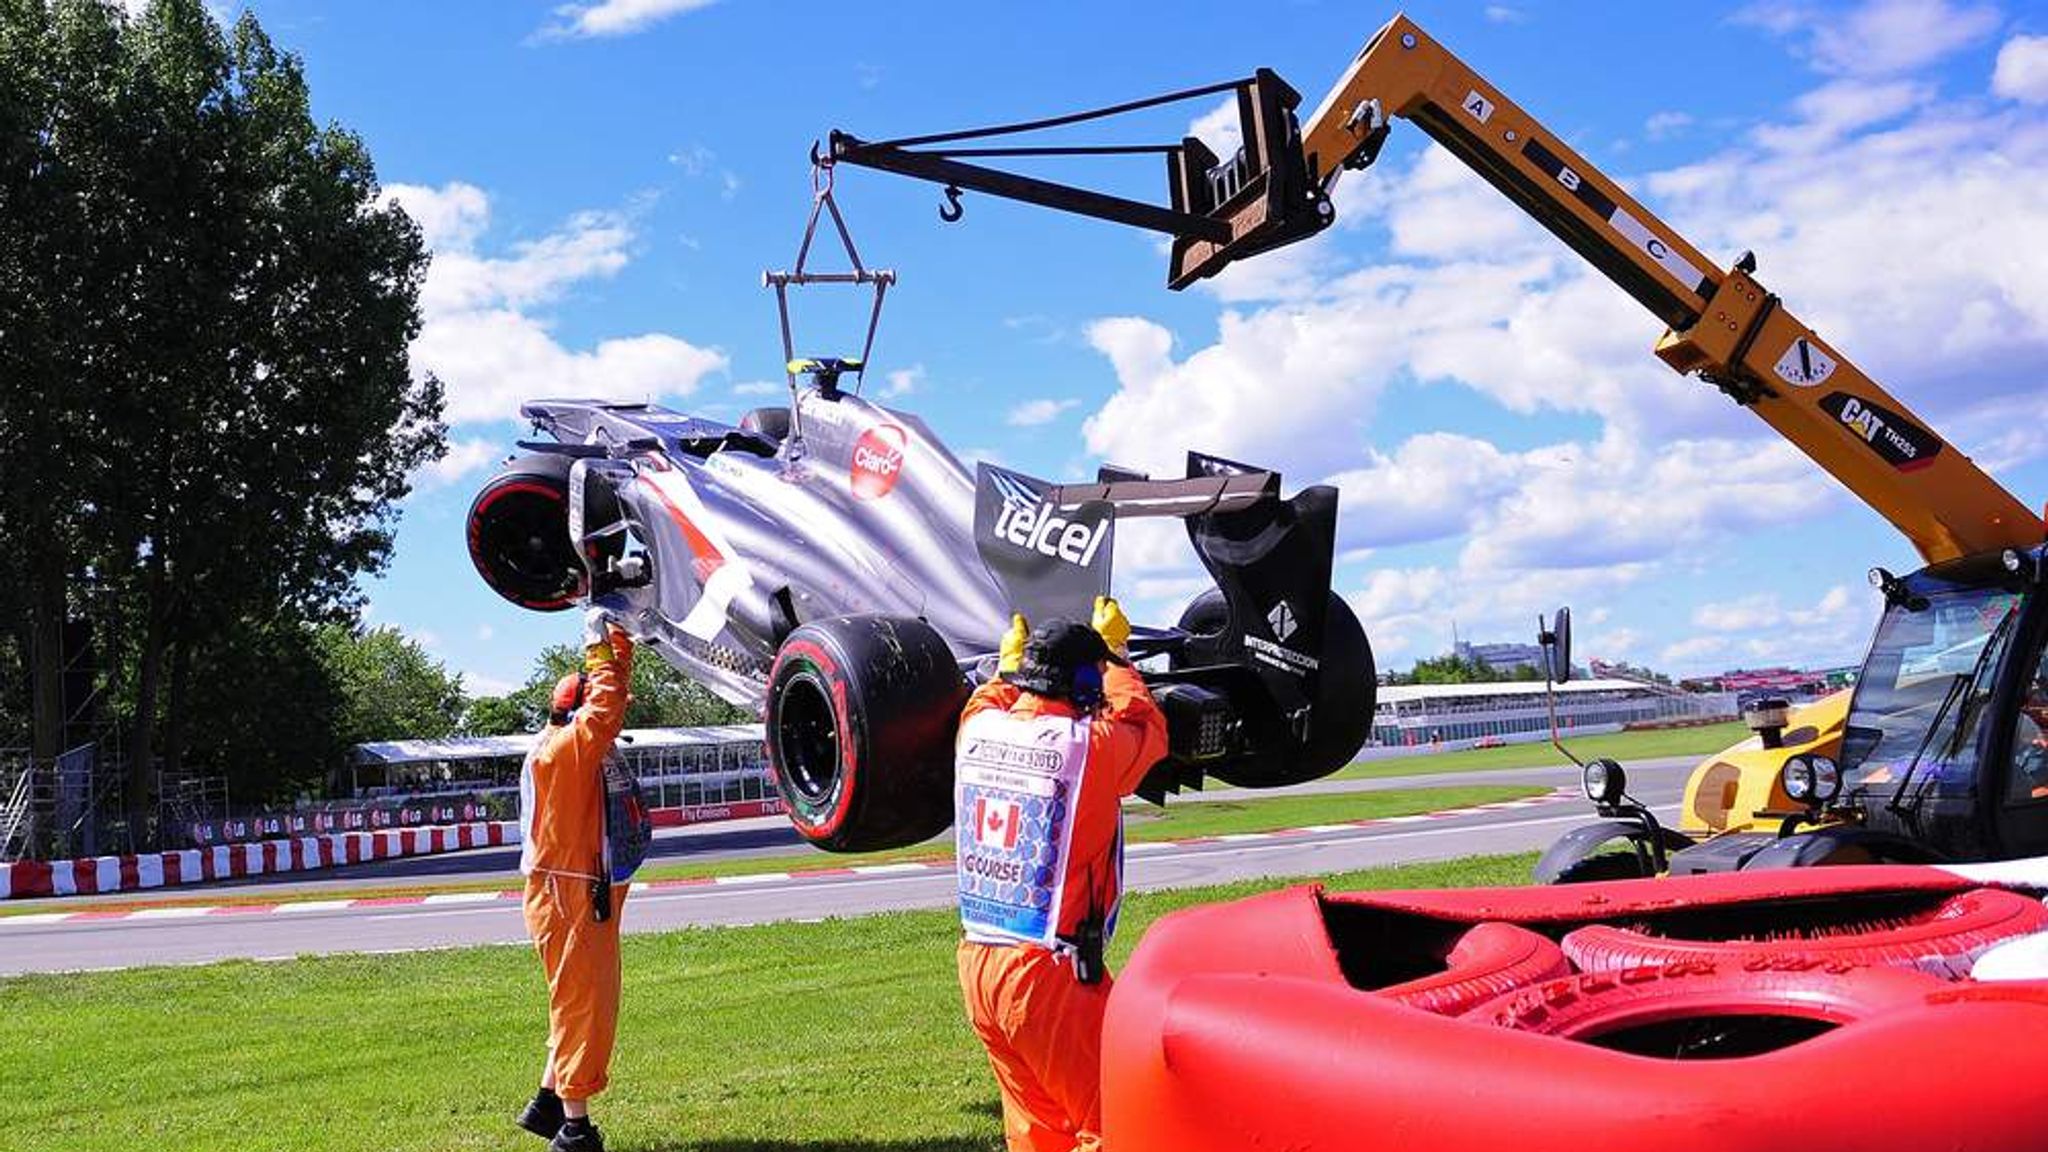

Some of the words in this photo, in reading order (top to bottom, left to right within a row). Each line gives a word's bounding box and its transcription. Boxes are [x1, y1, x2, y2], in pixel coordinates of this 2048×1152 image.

[1468, 99, 1484, 117] A
[1556, 166, 1581, 192] B
[1646, 239, 1667, 259] C
[1841, 398, 1884, 442] CAT
[855, 446, 891, 475] Claro
[994, 499, 1109, 567] telcel
[475, 805, 487, 817] LG
